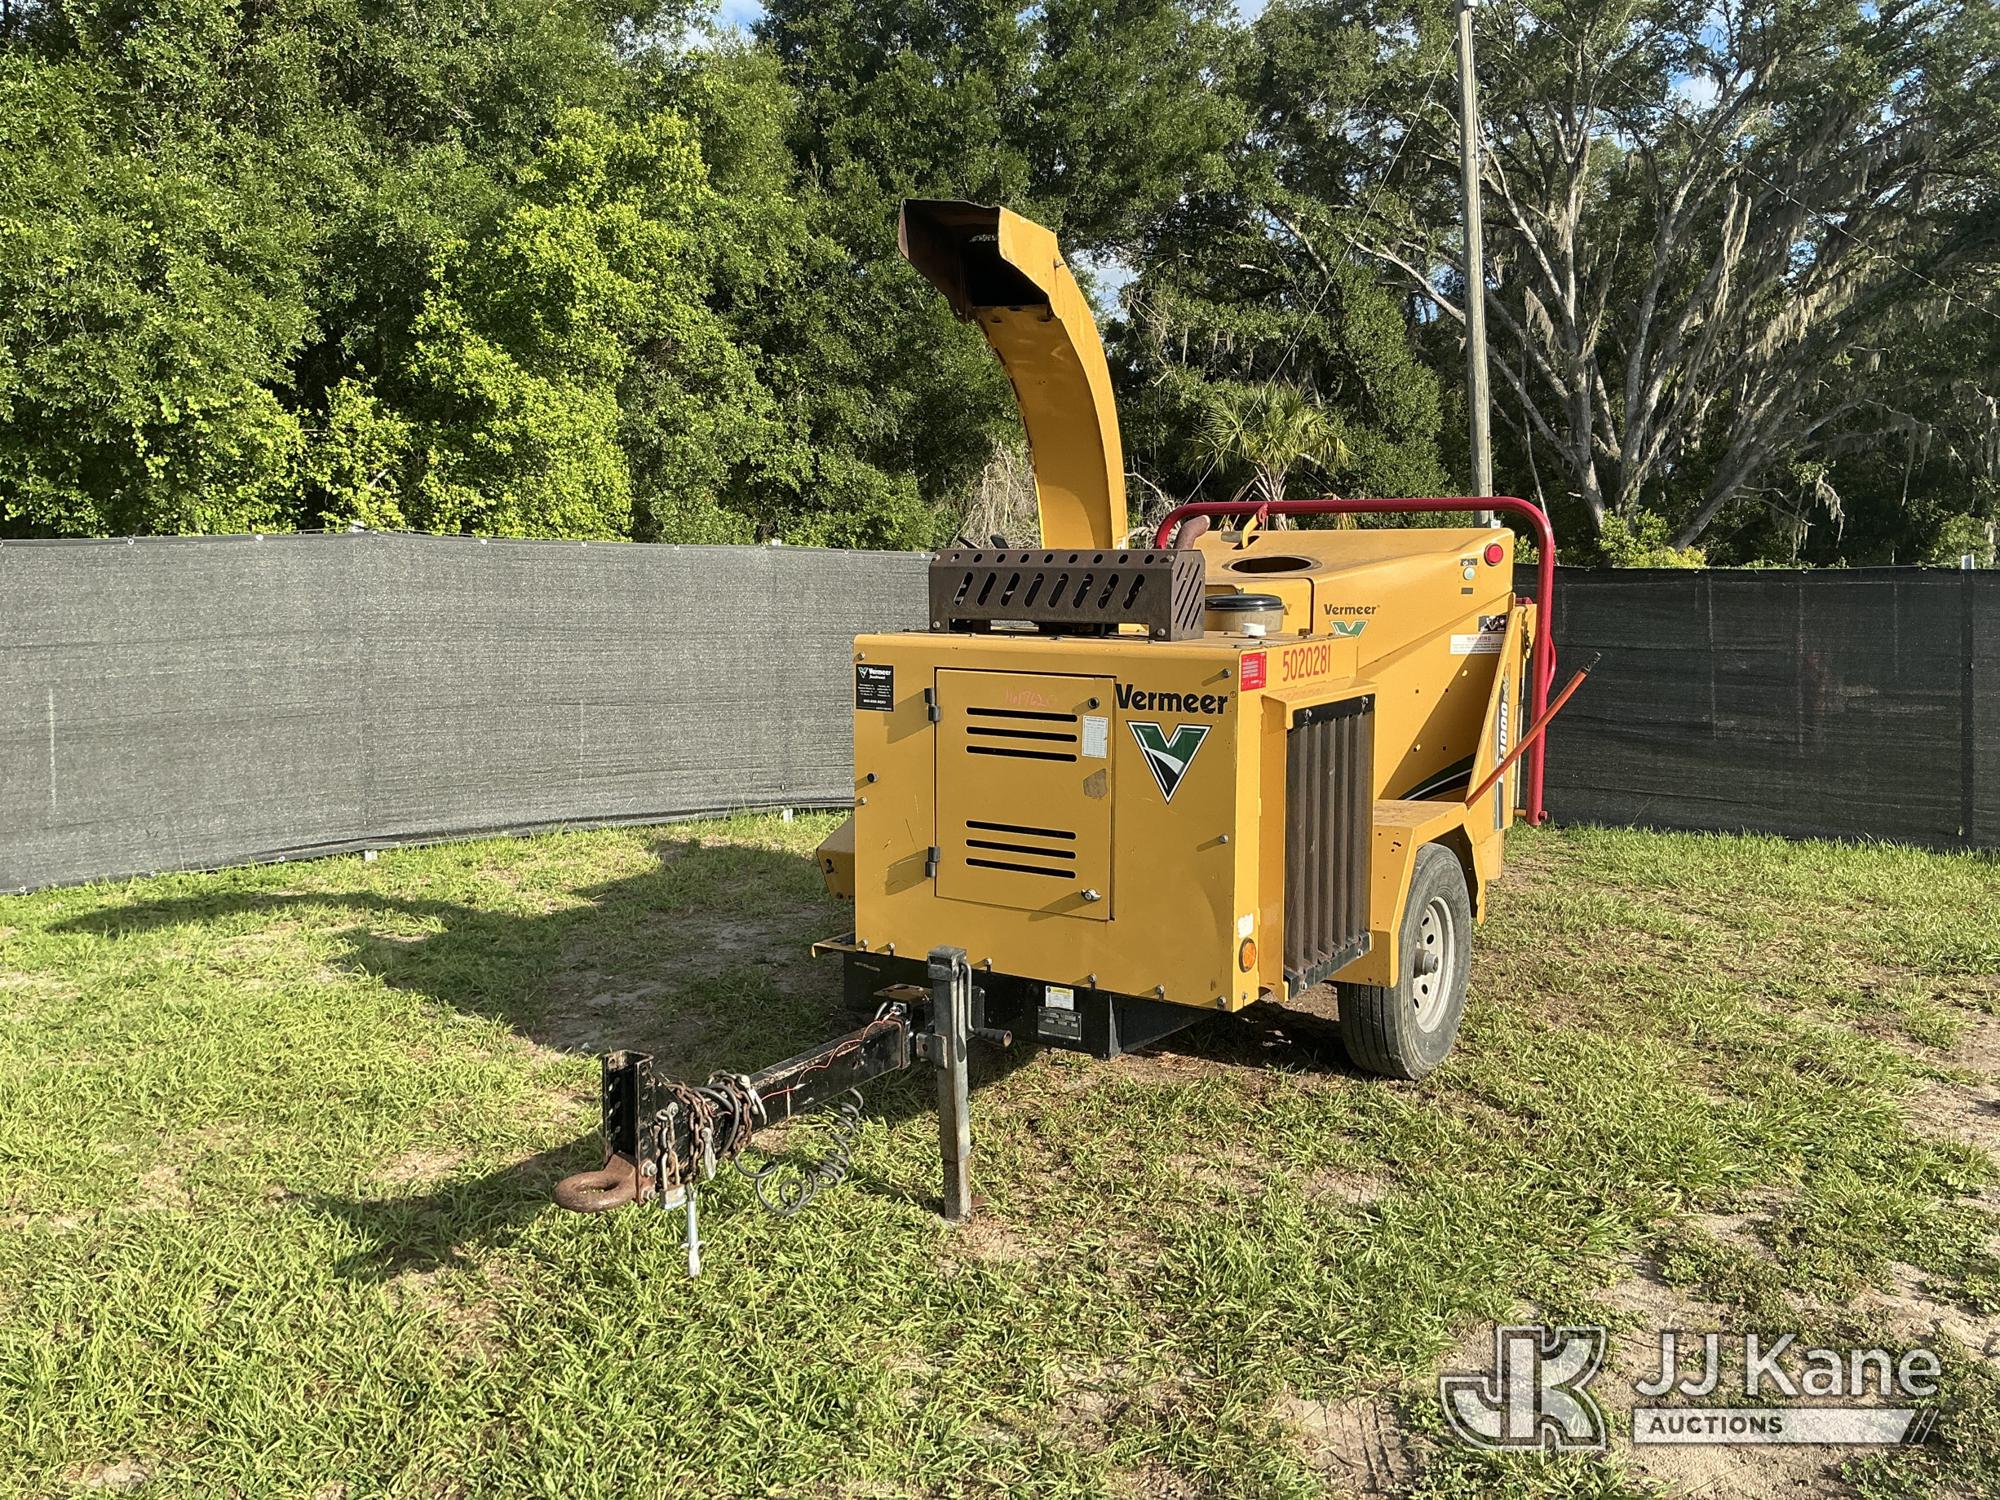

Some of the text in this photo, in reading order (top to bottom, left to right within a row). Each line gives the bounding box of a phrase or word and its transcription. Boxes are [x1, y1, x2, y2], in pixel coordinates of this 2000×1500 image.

[1324, 604, 1376, 615] Vermeer
[1282, 644, 1331, 682] 5020281
[1115, 684, 1228, 714] Vermeer
